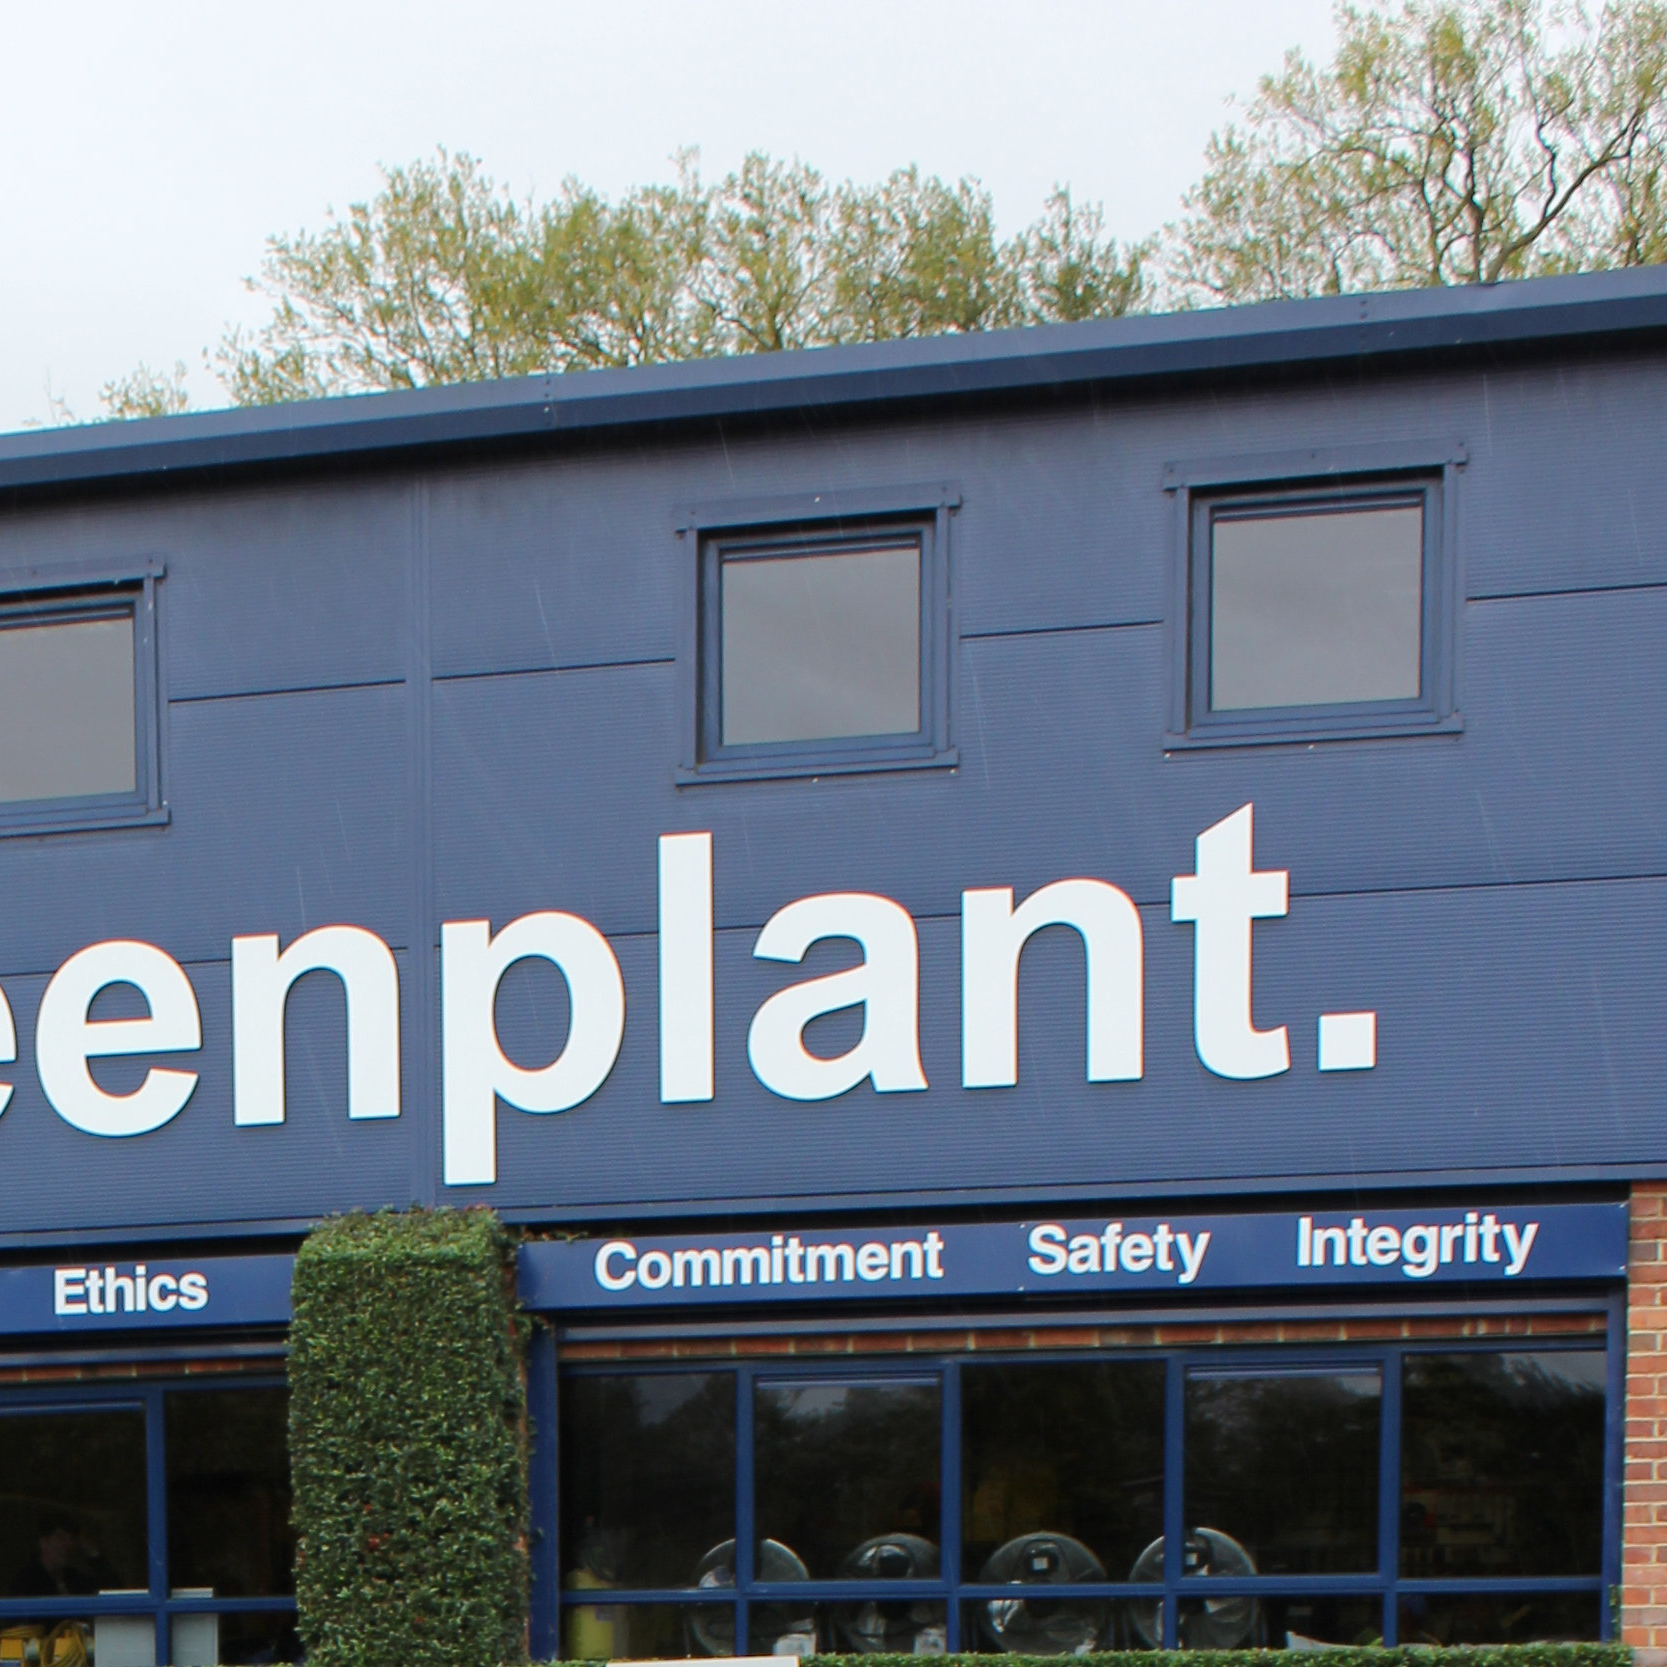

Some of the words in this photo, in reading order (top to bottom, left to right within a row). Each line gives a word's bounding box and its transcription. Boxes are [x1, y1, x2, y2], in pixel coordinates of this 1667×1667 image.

[593, 1230, 944, 1291] Commitment
[1027, 1221, 1211, 1283] Safety
[1296, 1212, 1539, 1277] Integrity
[53, 1265, 209, 1316] Ethics
